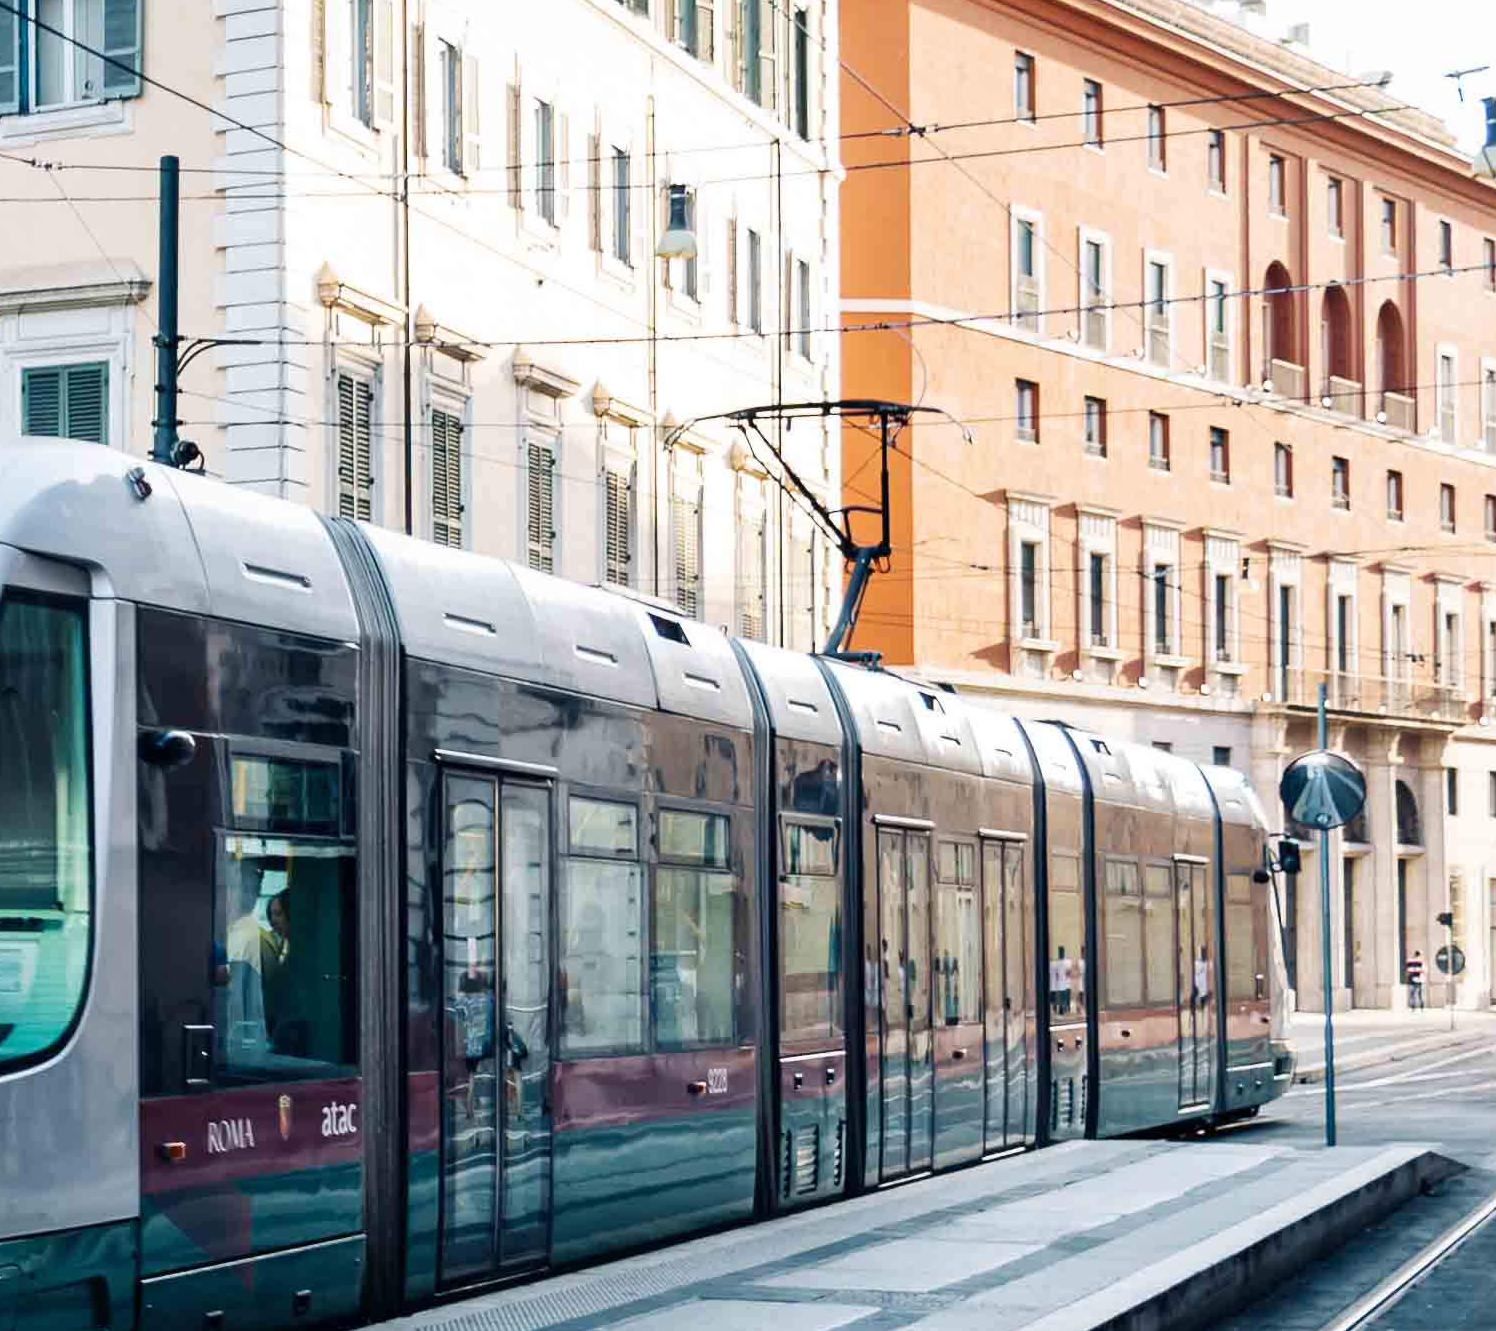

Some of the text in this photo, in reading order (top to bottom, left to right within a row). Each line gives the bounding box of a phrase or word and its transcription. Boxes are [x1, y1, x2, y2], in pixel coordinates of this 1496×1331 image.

[707, 1068, 728, 1094] 9228
[208, 1118, 256, 1153] ROMA
[321, 1101, 358, 1137] atac
